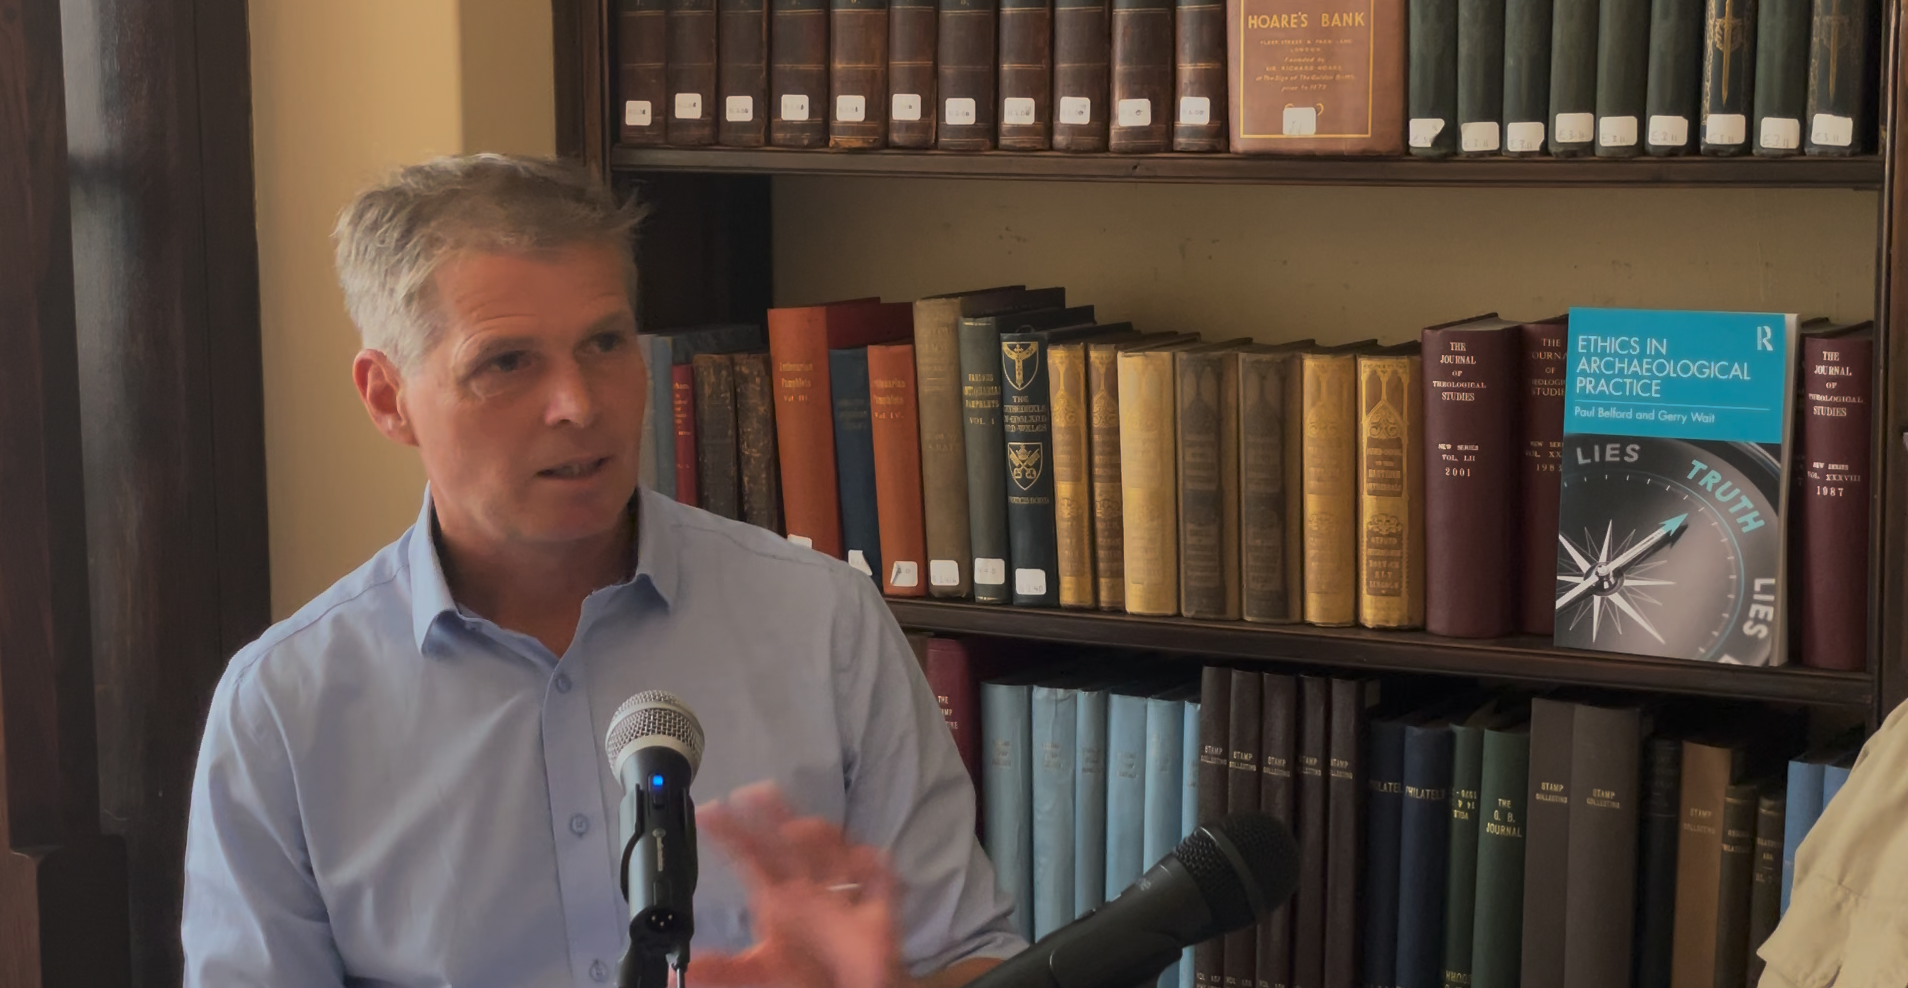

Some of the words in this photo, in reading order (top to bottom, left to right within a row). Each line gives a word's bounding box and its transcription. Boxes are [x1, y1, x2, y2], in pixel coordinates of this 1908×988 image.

[1248, 12, 1308, 29] HOARE'S
[1321, 12, 1365, 27] BANK
[1450, 342, 1466, 351] THE
[1542, 338, 1561, 347] THE
[1578, 335, 1639, 354] ETHICS
[1646, 338, 1667, 355] IN
[1440, 354, 1476, 364] JOURNAL
[1822, 351, 1839, 361] THE
[1576, 357, 1751, 380] ARCHAEOLOGICAL
[1814, 365, 1852, 376] JOURNAL
[1433, 380, 1486, 388] THEOLOGICAL
[1576, 377, 1662, 397] PRACTICE
[1441, 392, 1475, 401] STUDIES
[1808, 393, 1863, 403] THEOLOGICAL
[1574, 406, 1595, 418] Paul
[1597, 407, 1632, 420] Belford
[1635, 409, 1655, 420] and
[1658, 410, 1687, 424] Gerry
[1691, 412, 1715, 423] Wait
[1813, 406, 1847, 417] STUDIES
[1576, 443, 1641, 465] LIES
[1445, 468, 1471, 476] 2001
[1686, 459, 1765, 533] TRUTH
[1817, 486, 1844, 497] 1987
[1743, 578, 1776, 640] LIES
[938, 695, 949, 704] THE
[1541, 782, 1564, 792] STAMP
[1592, 788, 1616, 799] STAMP
[1498, 798, 1511, 808] THE
[1486, 822, 1522, 837] JOURNAL
